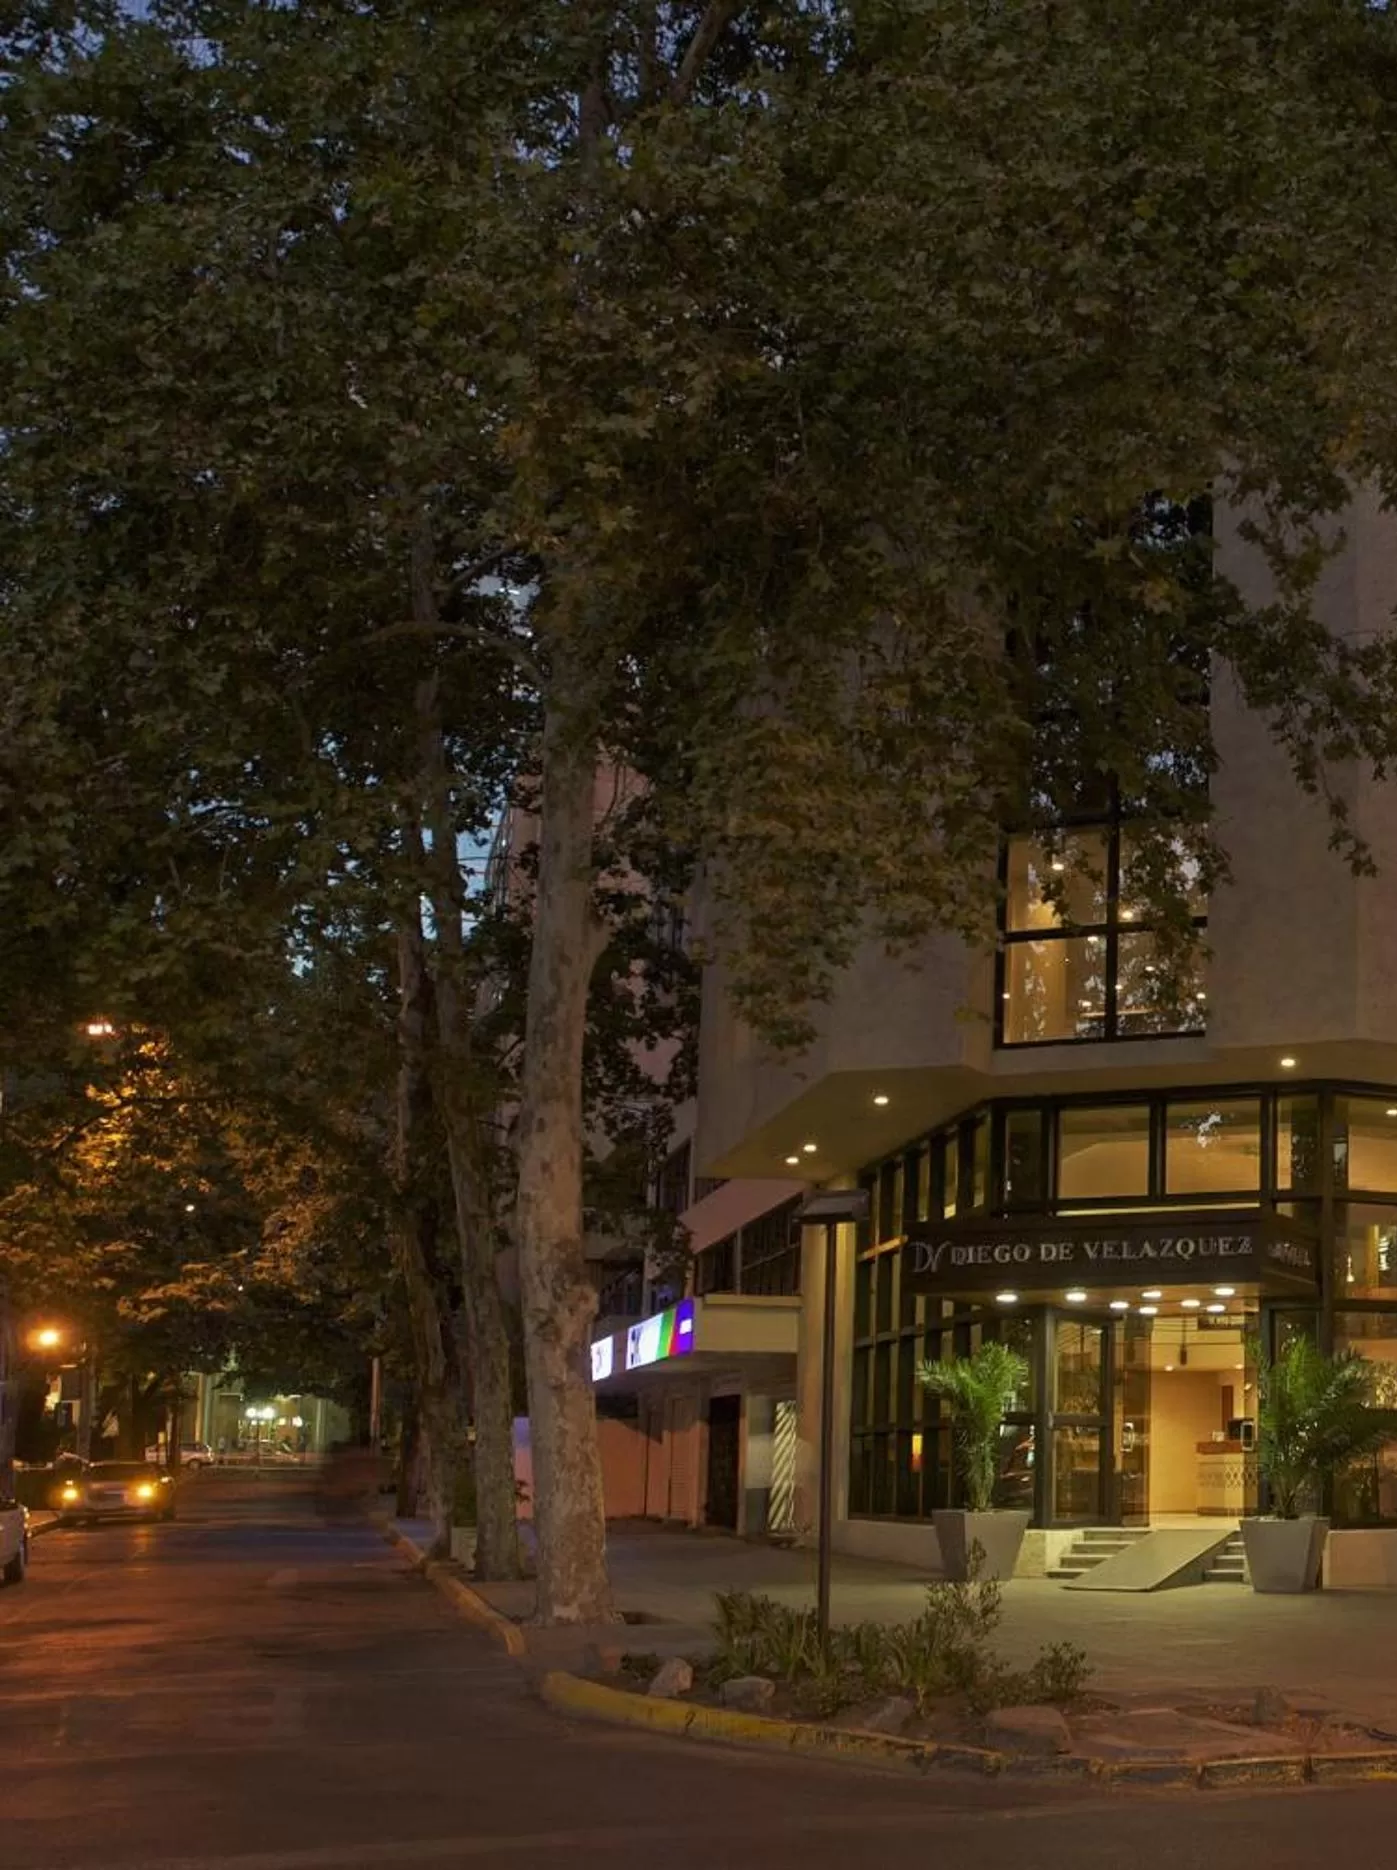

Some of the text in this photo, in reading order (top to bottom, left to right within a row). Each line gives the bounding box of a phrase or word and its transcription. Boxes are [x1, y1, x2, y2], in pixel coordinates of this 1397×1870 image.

[951, 1244, 1032, 1265] DIEGO
[1040, 1242, 1075, 1261] DE
[1084, 1236, 1253, 1260] VELAZQUEZ
